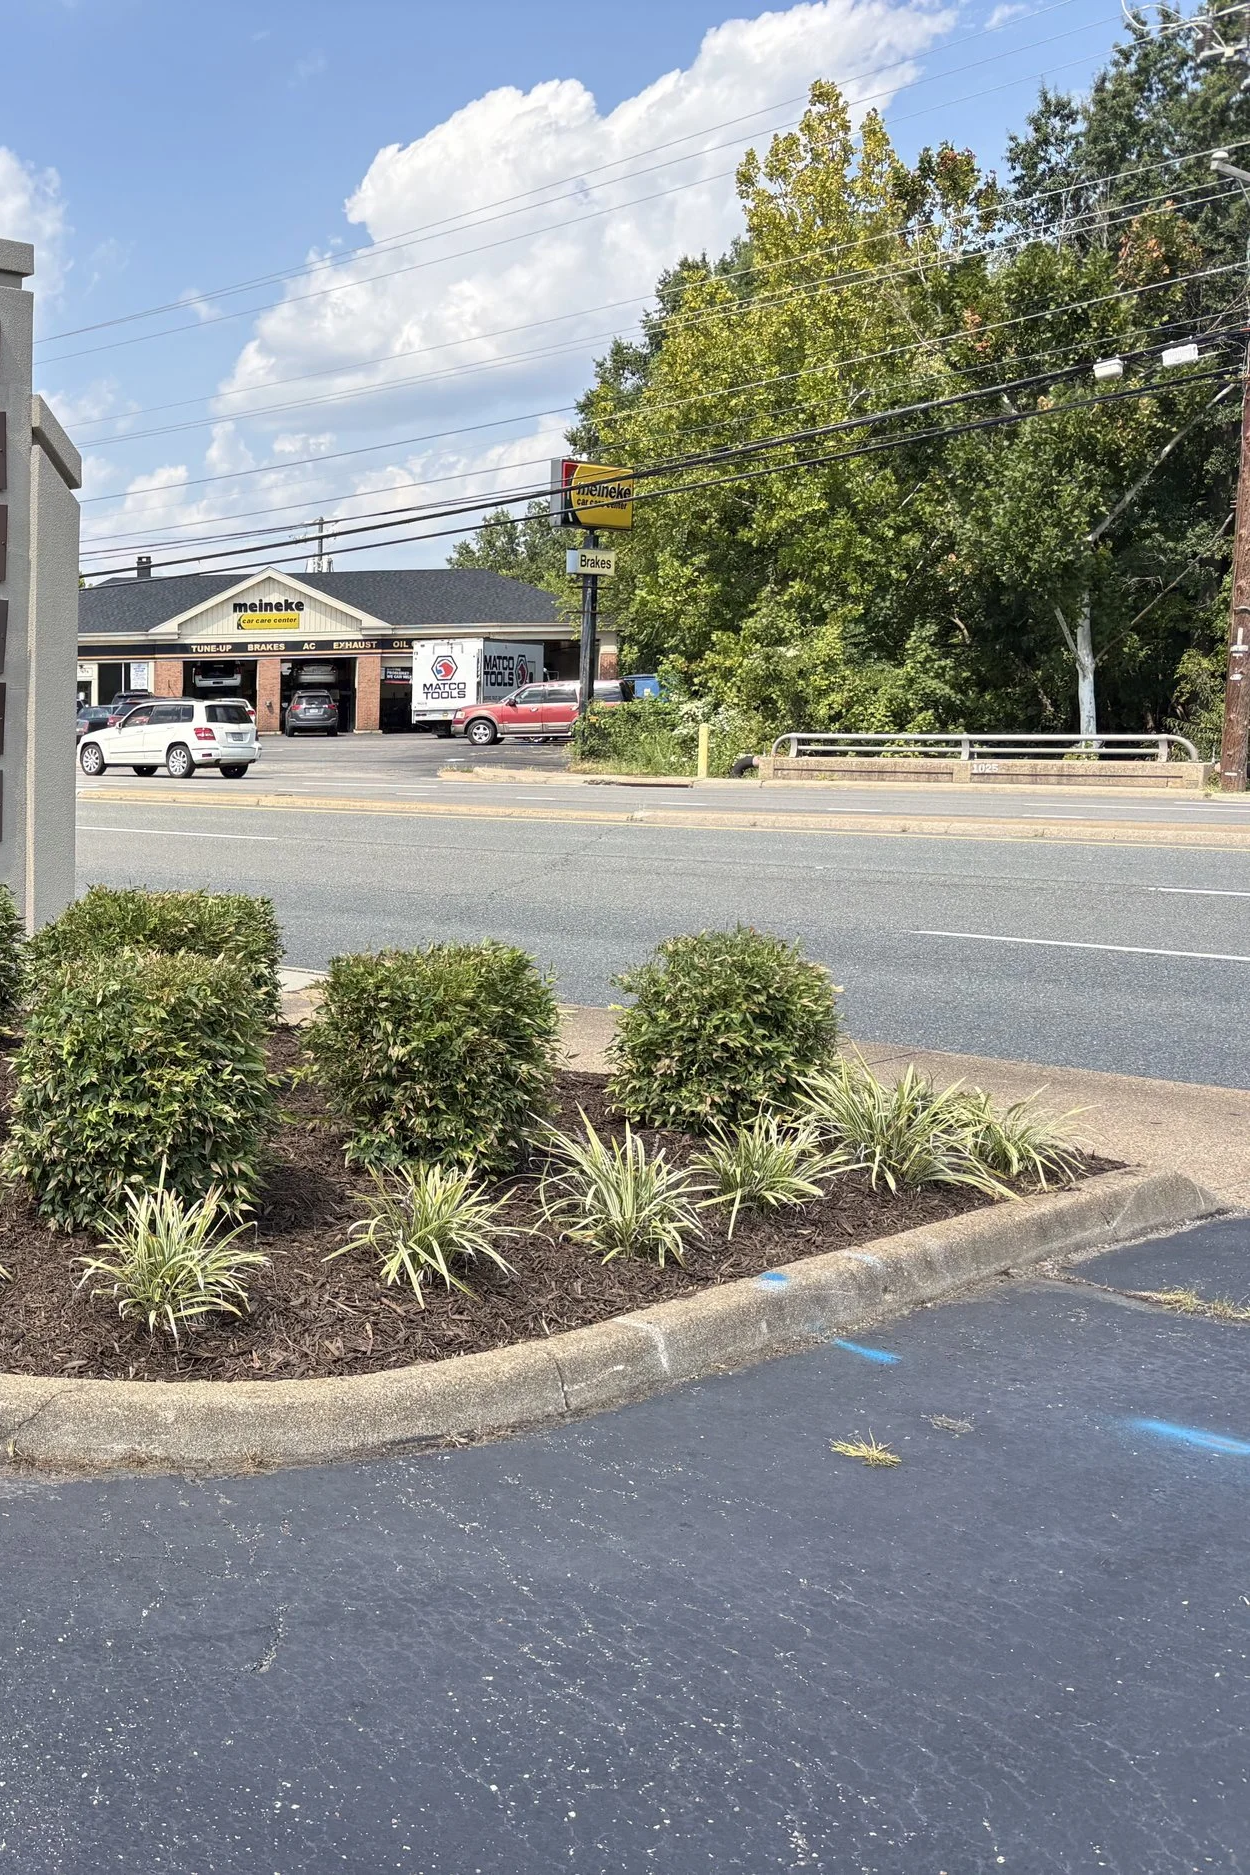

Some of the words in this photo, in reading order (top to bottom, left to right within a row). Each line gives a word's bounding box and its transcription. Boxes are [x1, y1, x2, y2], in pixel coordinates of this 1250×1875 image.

[580, 554, 612, 570] Brakes
[233, 598, 305, 613] meineke
[191, 645, 232, 653] TUNE-UP
[247, 643, 285, 652] BRAKES
[303, 642, 316, 650] AC
[333, 641, 378, 650] EXHAUST
[393, 640, 409, 648] OIL
[483, 655, 514, 671] MATCO
[484, 671, 514, 687] TOOLS
[423, 682, 466, 692] MATCO
[423, 691, 466, 700] TOOLS
[972, 763, 999, 774] 1025
